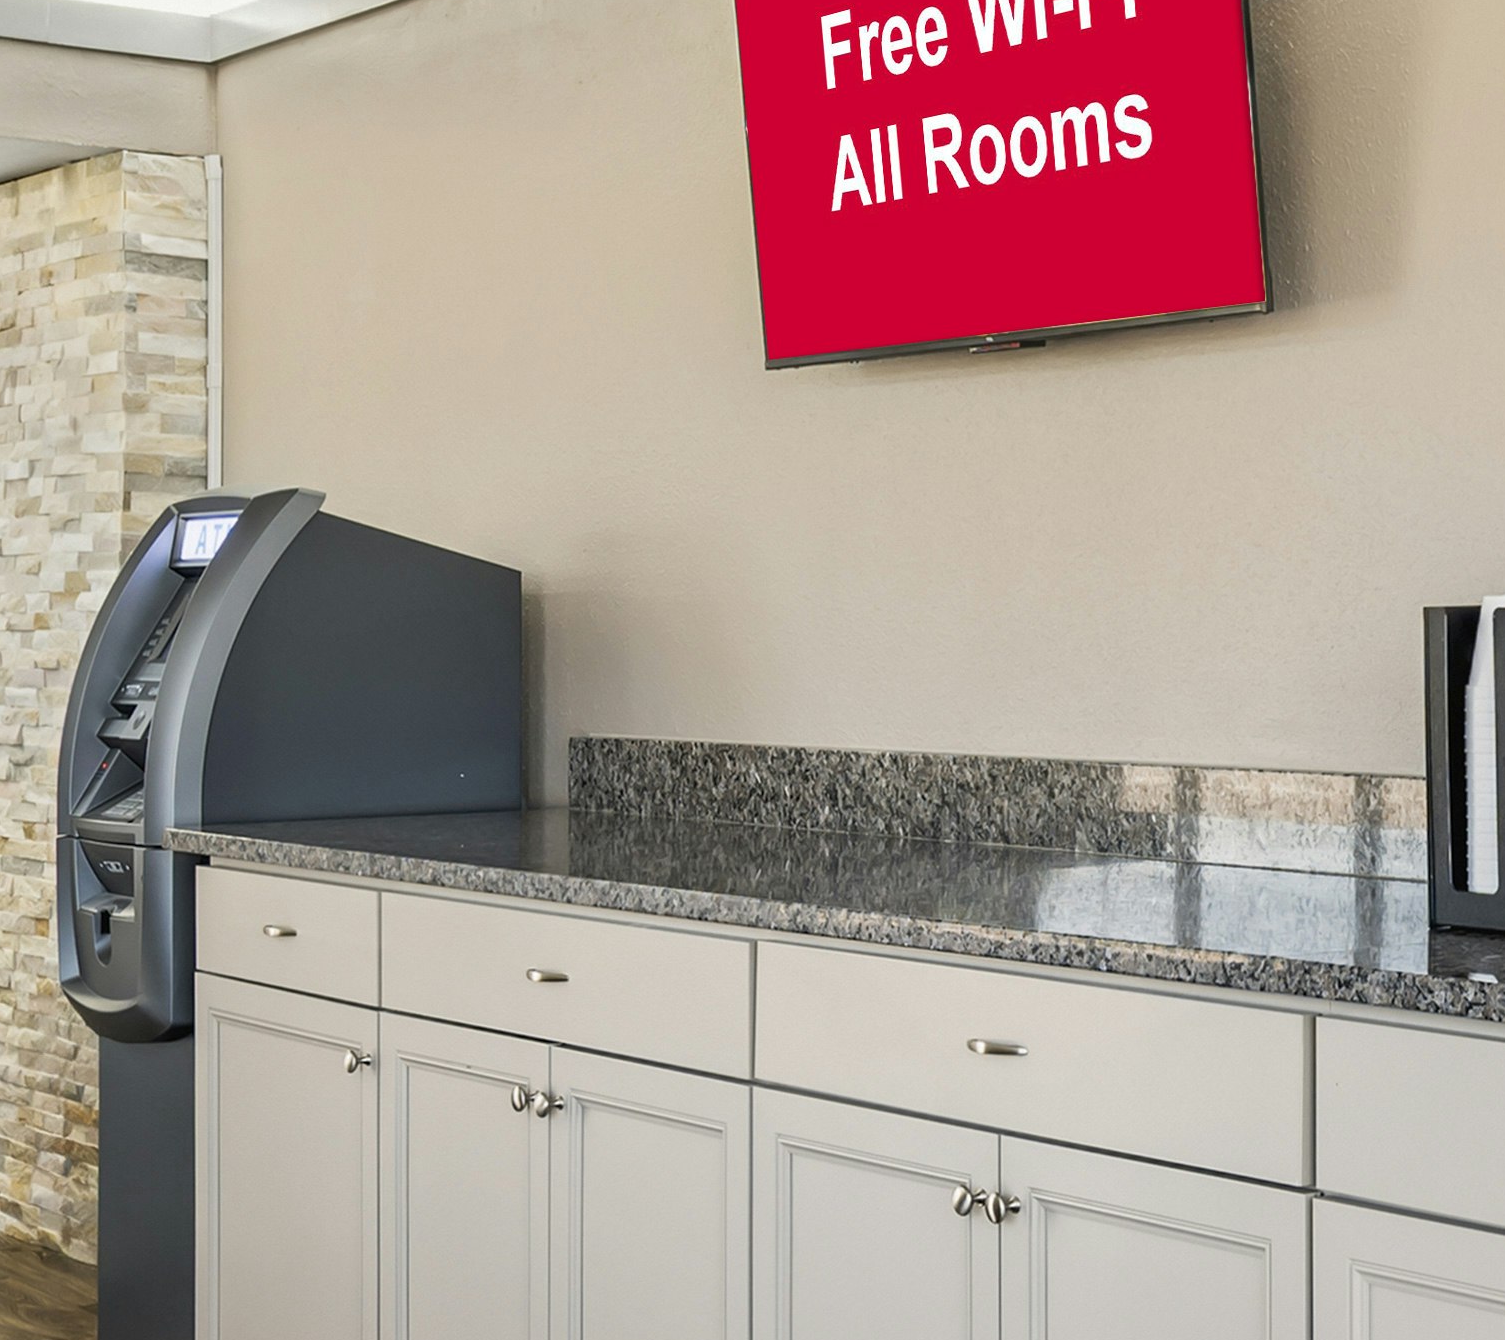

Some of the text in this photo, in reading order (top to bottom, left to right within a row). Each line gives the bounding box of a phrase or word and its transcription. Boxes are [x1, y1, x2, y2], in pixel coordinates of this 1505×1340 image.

[821, 6, 948, 90] Free
[831, 94, 1153, 212] All Rooms
[195, 522, 233, 555] AT
